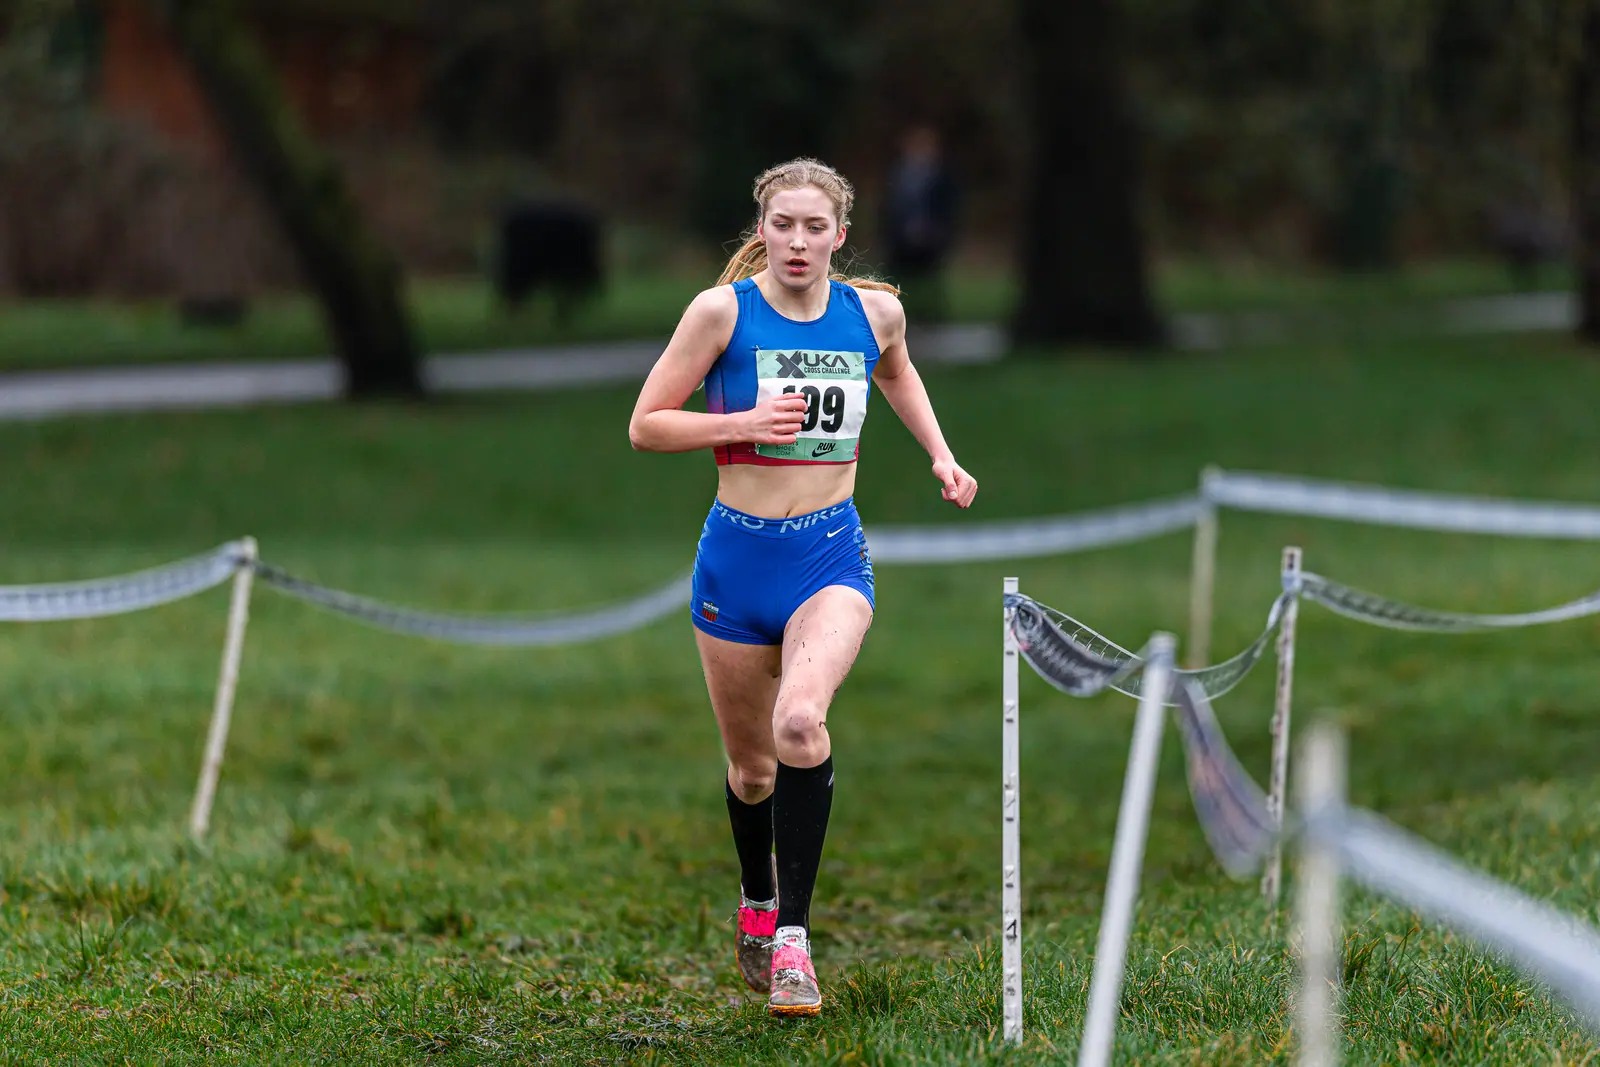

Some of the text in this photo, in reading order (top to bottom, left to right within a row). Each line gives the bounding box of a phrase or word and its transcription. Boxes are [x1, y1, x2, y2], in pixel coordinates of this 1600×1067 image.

[803, 353, 849, 368] UKA
[821, 367, 851, 375] CHALLENGE
[817, 442, 836, 451] RUN
